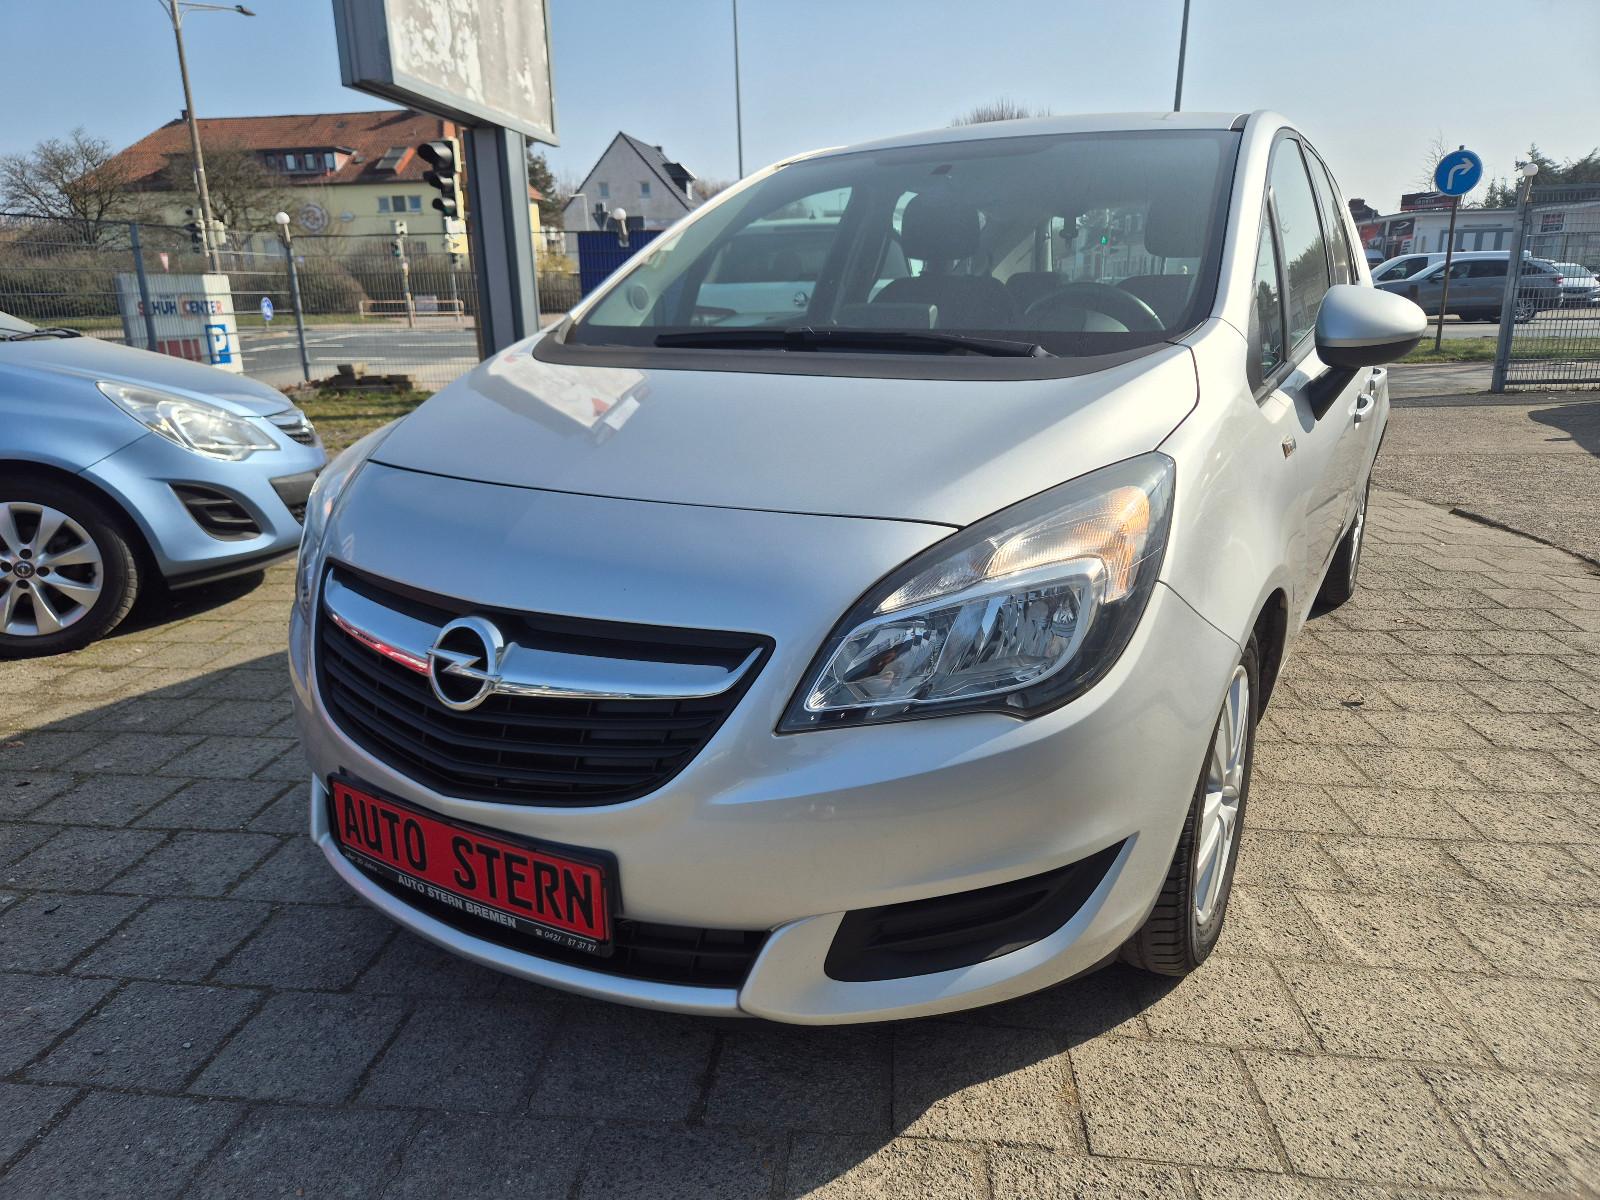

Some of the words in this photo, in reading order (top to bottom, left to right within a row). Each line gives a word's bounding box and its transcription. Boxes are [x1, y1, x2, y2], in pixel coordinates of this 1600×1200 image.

[138, 300, 178, 316] SHUH
[209, 327, 228, 362] P
[343, 792, 428, 872] AUTO
[451, 836, 595, 930] STERN
[398, 875, 425, 894] AUTO
[427, 885, 463, 910] STERN
[465, 903, 517, 929] BREMEN
[544, 931, 563, 943] 0421
